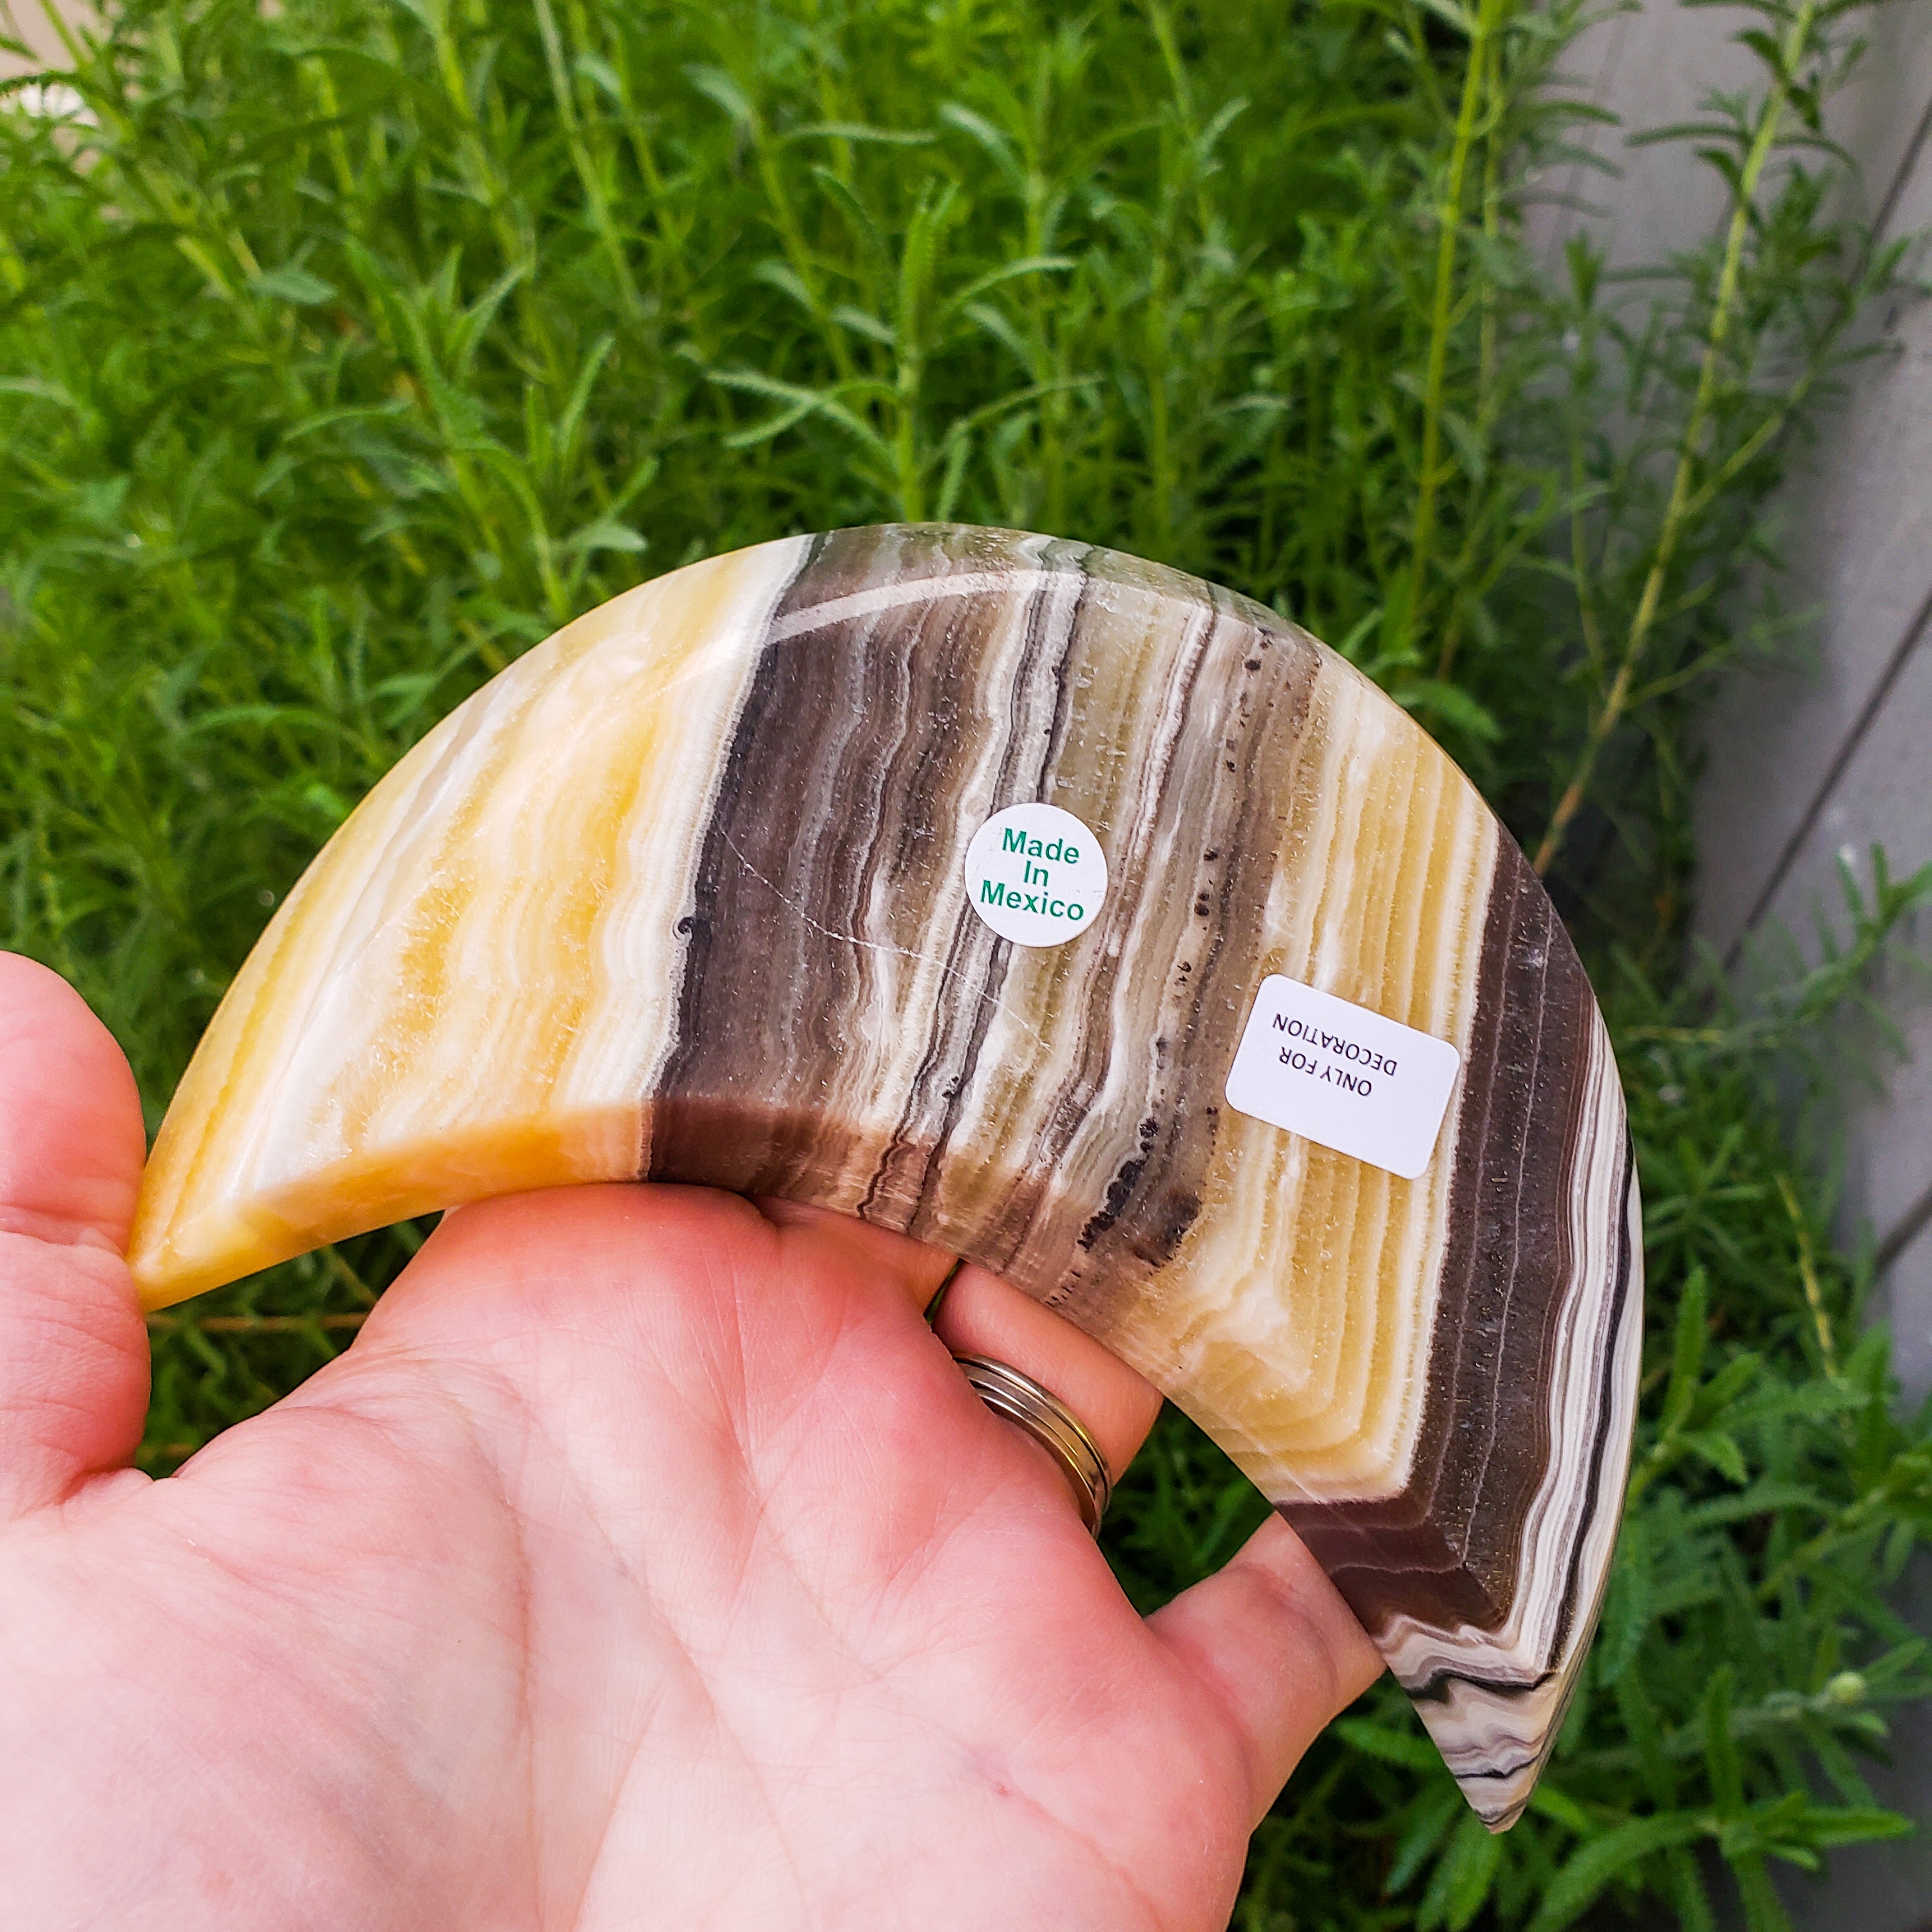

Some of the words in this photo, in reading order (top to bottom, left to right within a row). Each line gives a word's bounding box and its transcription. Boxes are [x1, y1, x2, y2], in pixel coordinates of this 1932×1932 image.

[1002, 828, 1079, 864] Made
[1023, 860, 1049, 887] In
[980, 880, 1084, 921] Mexico
[1273, 1014, 1397, 1076] DECORATION
[1279, 1046, 1318, 1074] FOR
[1320, 1065, 1372, 1096] ONLY
